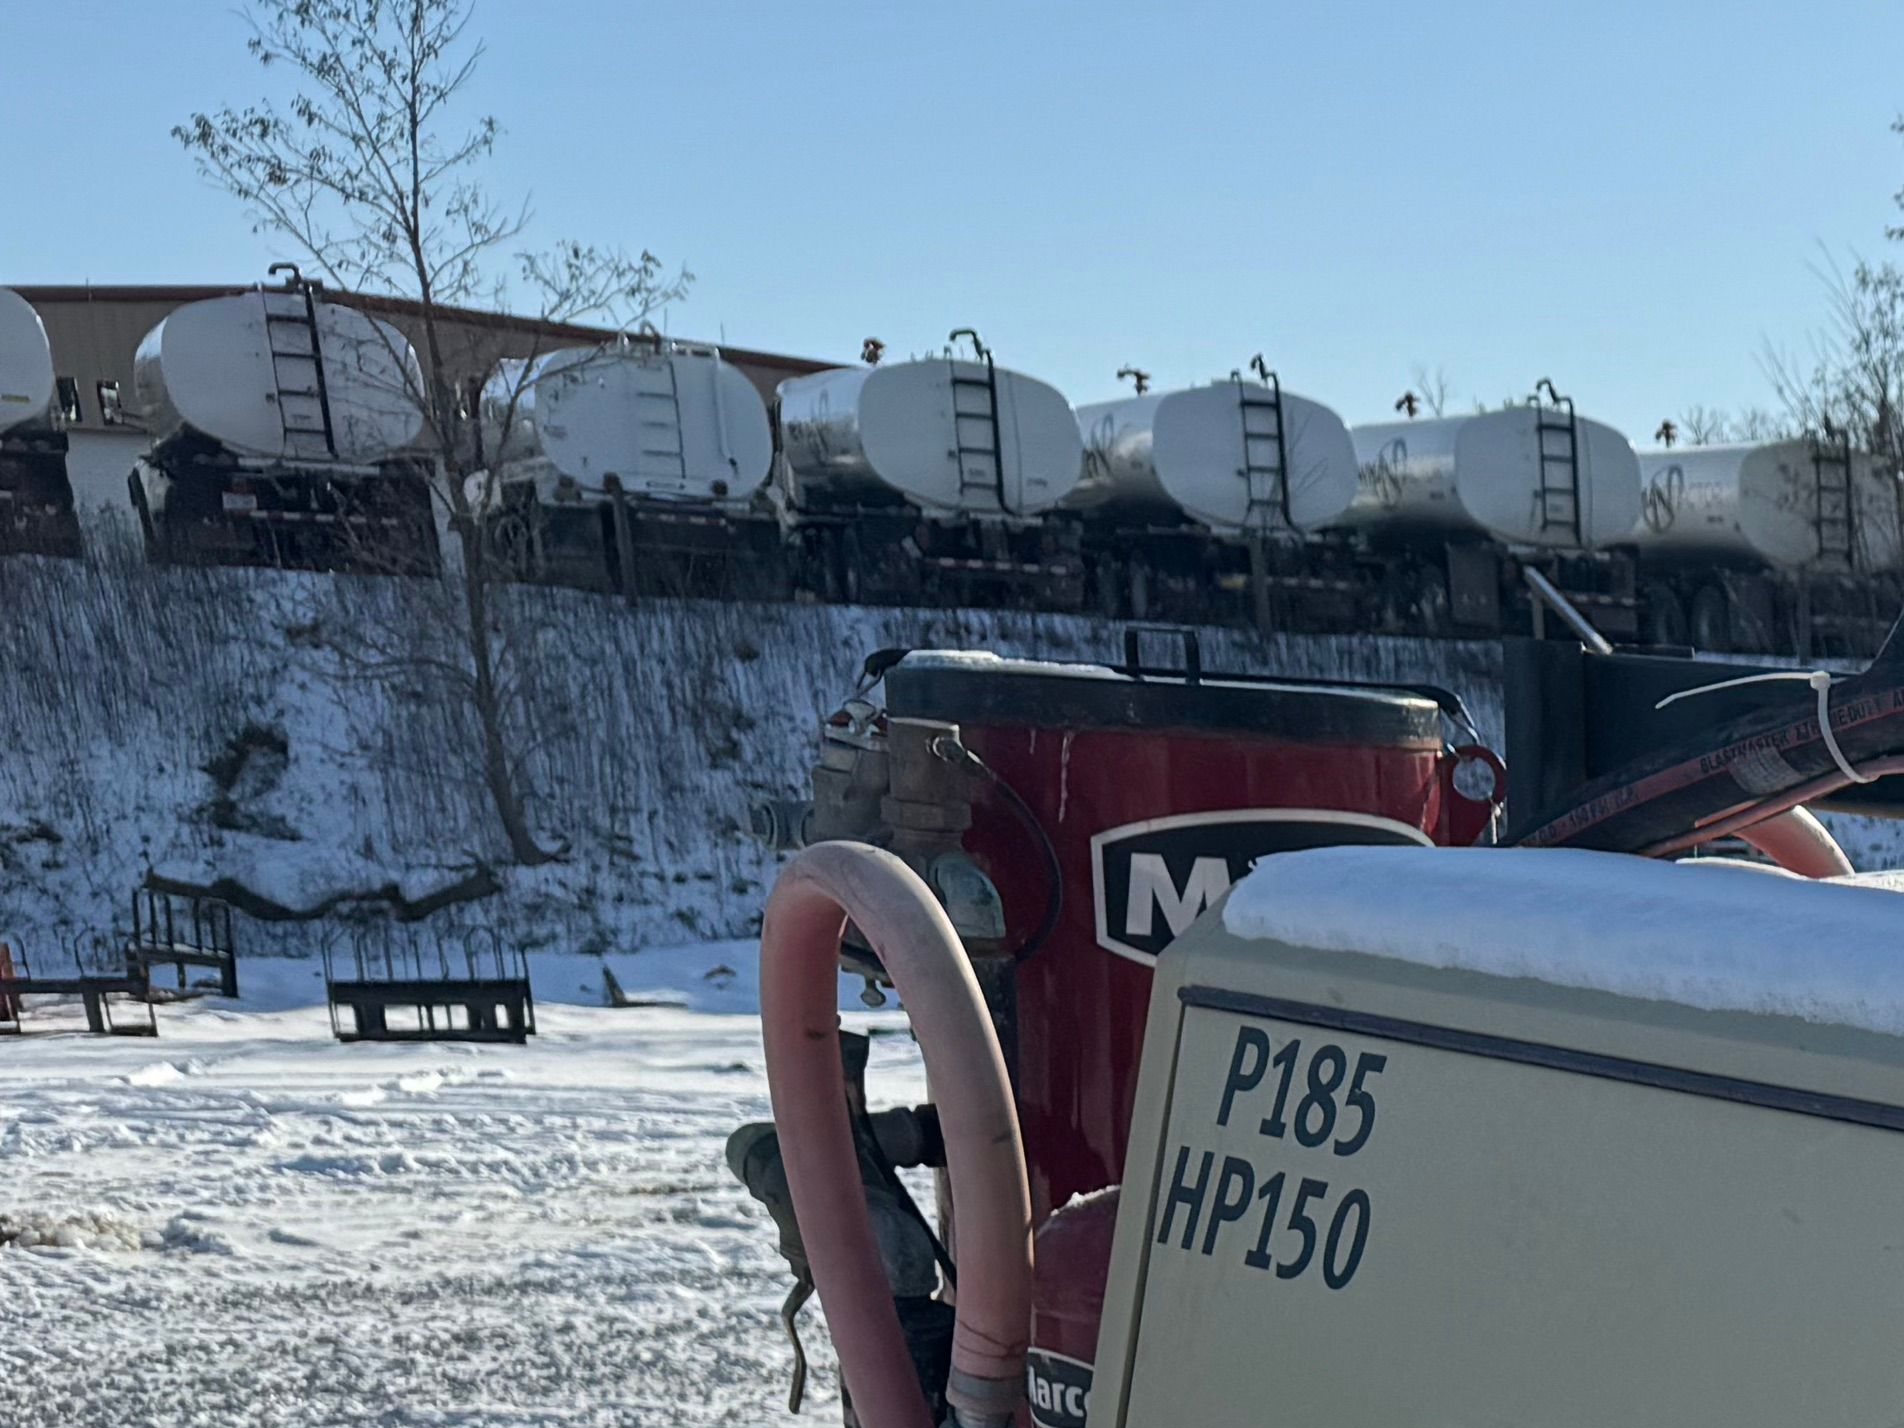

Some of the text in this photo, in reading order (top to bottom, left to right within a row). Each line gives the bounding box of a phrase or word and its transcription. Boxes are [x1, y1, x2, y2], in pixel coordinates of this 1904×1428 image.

[1216, 1024, 1388, 1157] P185
[1156, 1145, 1372, 1291] HP150
[1028, 1365, 1091, 1418] arc
